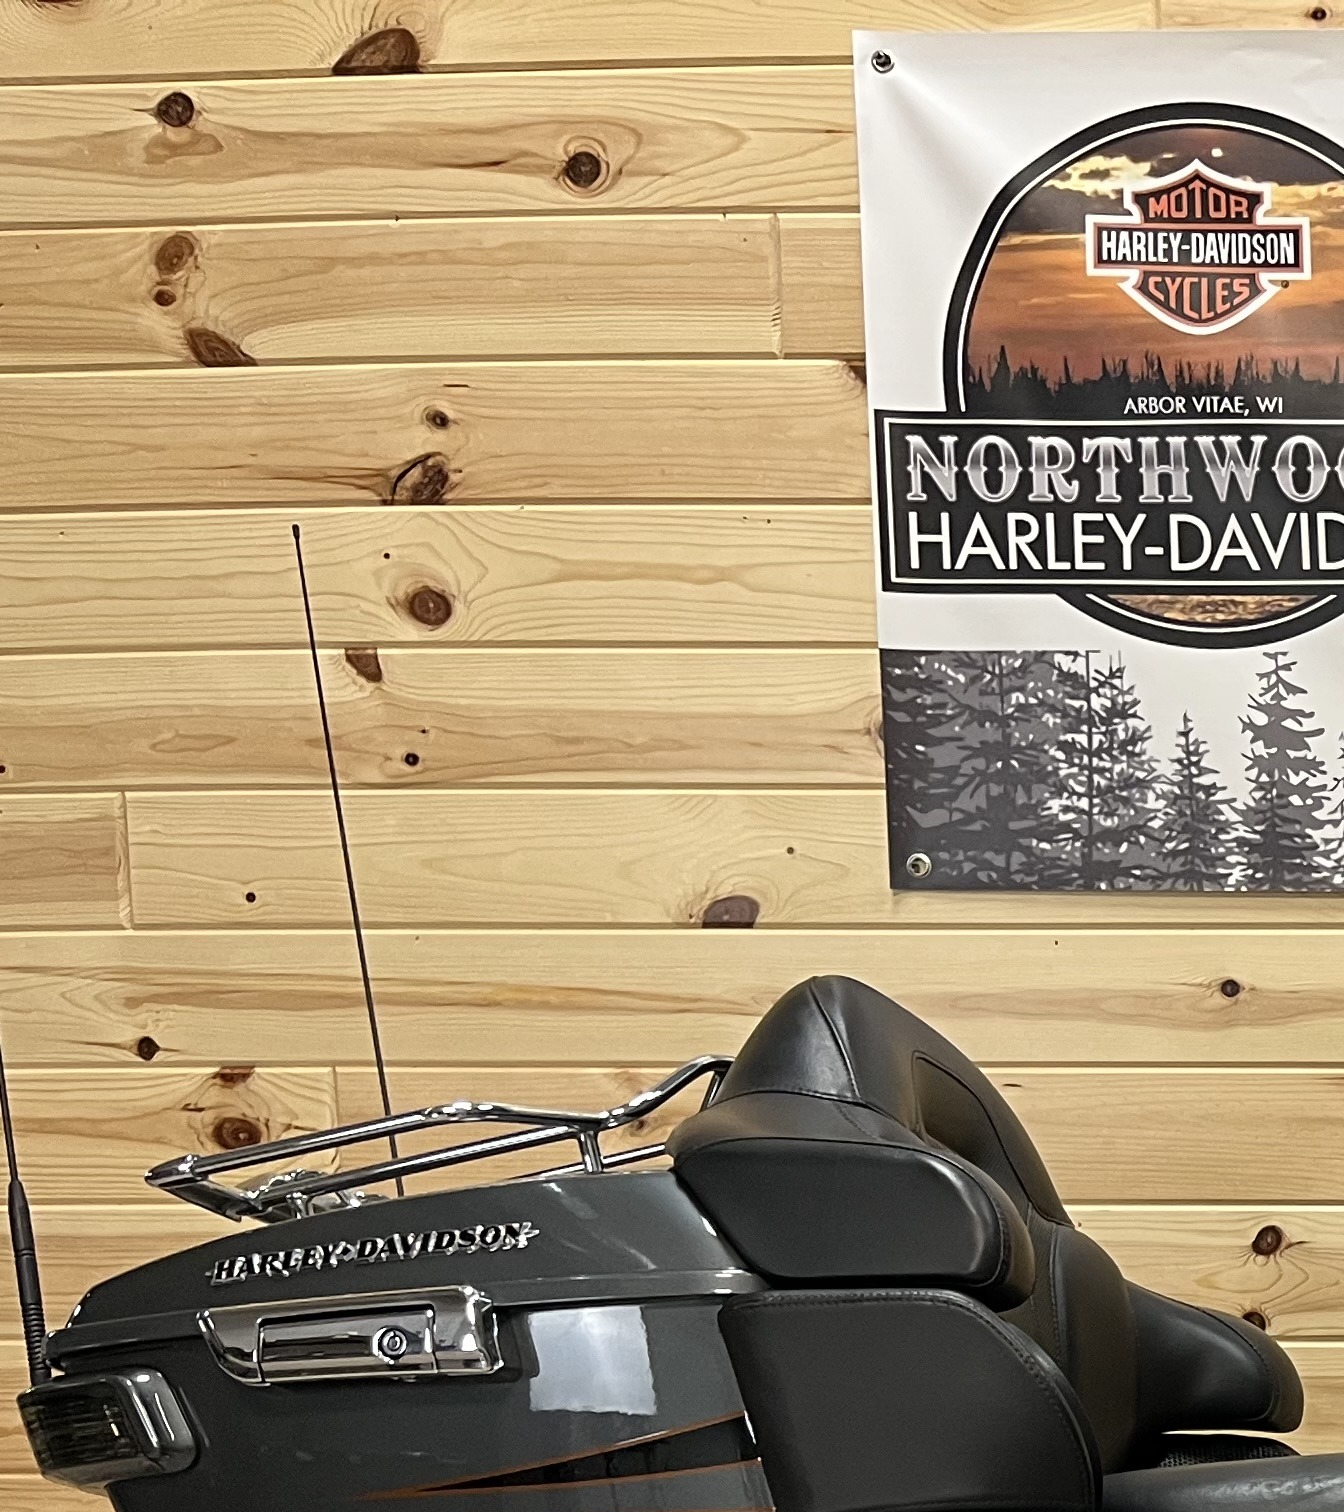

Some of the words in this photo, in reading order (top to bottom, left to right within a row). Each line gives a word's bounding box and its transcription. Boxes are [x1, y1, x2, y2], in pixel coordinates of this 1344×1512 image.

[1148, 178, 1249, 219] MOTOR
[1101, 230, 1295, 265] HARLEY-DAVIDSON
[1148, 276, 1250, 320] CYCLES
[1124, 396, 1187, 414] ARBOR
[1192, 396, 1249, 416] VITAE,
[1256, 396, 1283, 414] WI
